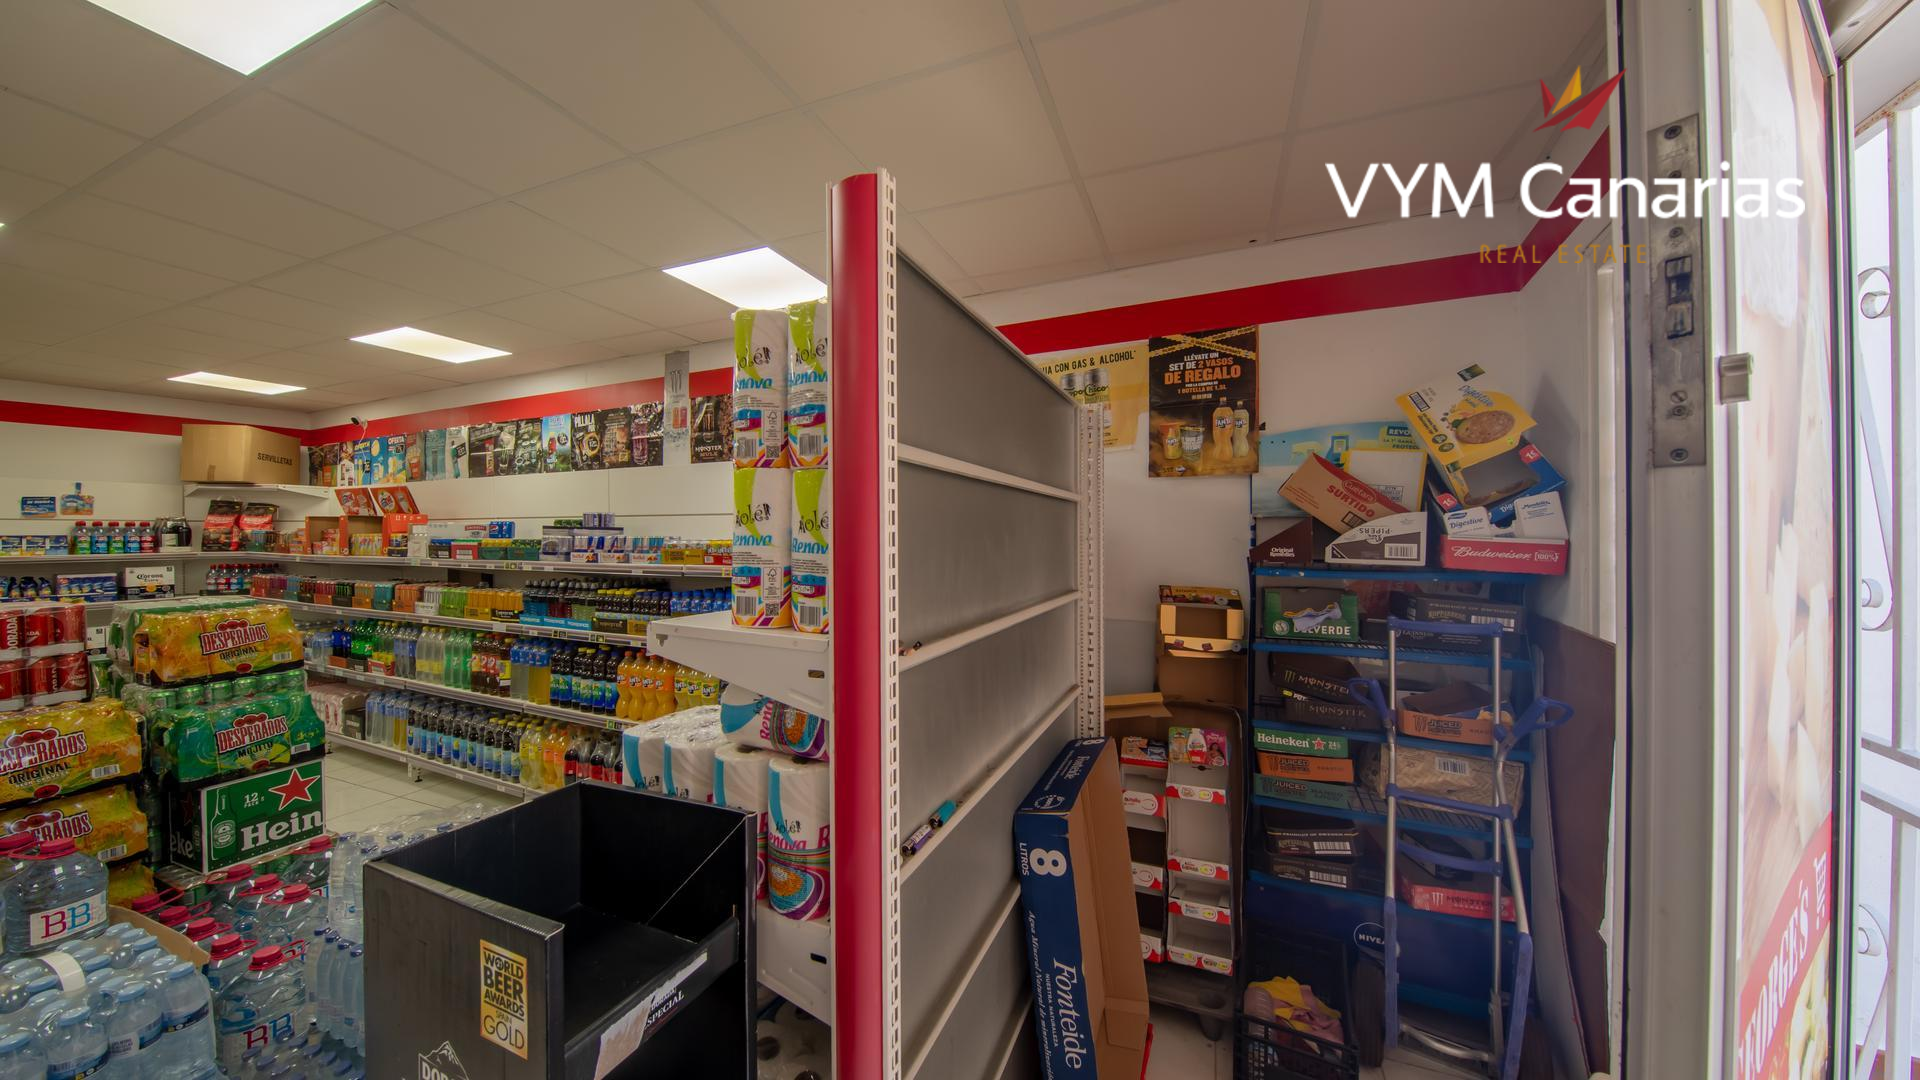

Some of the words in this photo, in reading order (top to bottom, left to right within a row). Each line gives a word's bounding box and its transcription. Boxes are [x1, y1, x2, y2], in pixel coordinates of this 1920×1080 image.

[1055, 362, 1070, 374] CON
[1072, 358, 1087, 370] GAS
[1090, 357, 1095, 367] &
[1164, 372, 1182, 385] DE
[1184, 364, 1242, 383] REGALO
[1169, 362, 1184, 371] SET
[1186, 361, 1197, 369] DE
[1205, 357, 1234, 367] VASOS
[257, 452, 293, 466] SERVILLETAS
[1327, 484, 1375, 518] SURTIDO
[1358, 527, 1391, 535] PIPERS
[1450, 517, 1484, 529] Digestive
[1450, 546, 1533, 561] Budweiser
[201, 624, 270, 652] DESPERADOS
[219, 646, 258, 660] ORIGINAL
[217, 716, 288, 752] DESPERADOS
[1257, 732, 1310, 748] Heineken
[0, 733, 87, 774] SPERADOS
[8, 762, 72, 785] ORIGINAL
[244, 793, 259, 803] 12
[240, 811, 324, 852] Hein
[1019, 842, 1030, 876] LITROS
[1029, 847, 1067, 877] 8
[41, 901, 92, 939] BB
[483, 951, 524, 980] WORLD
[483, 965, 524, 1004] BEER
[484, 988, 525, 1017] AWARDS
[1053, 957, 1087, 1070] Fonteide
[495, 1009, 513, 1025] SPAIN
[483, 1014, 525, 1050] GOLD
